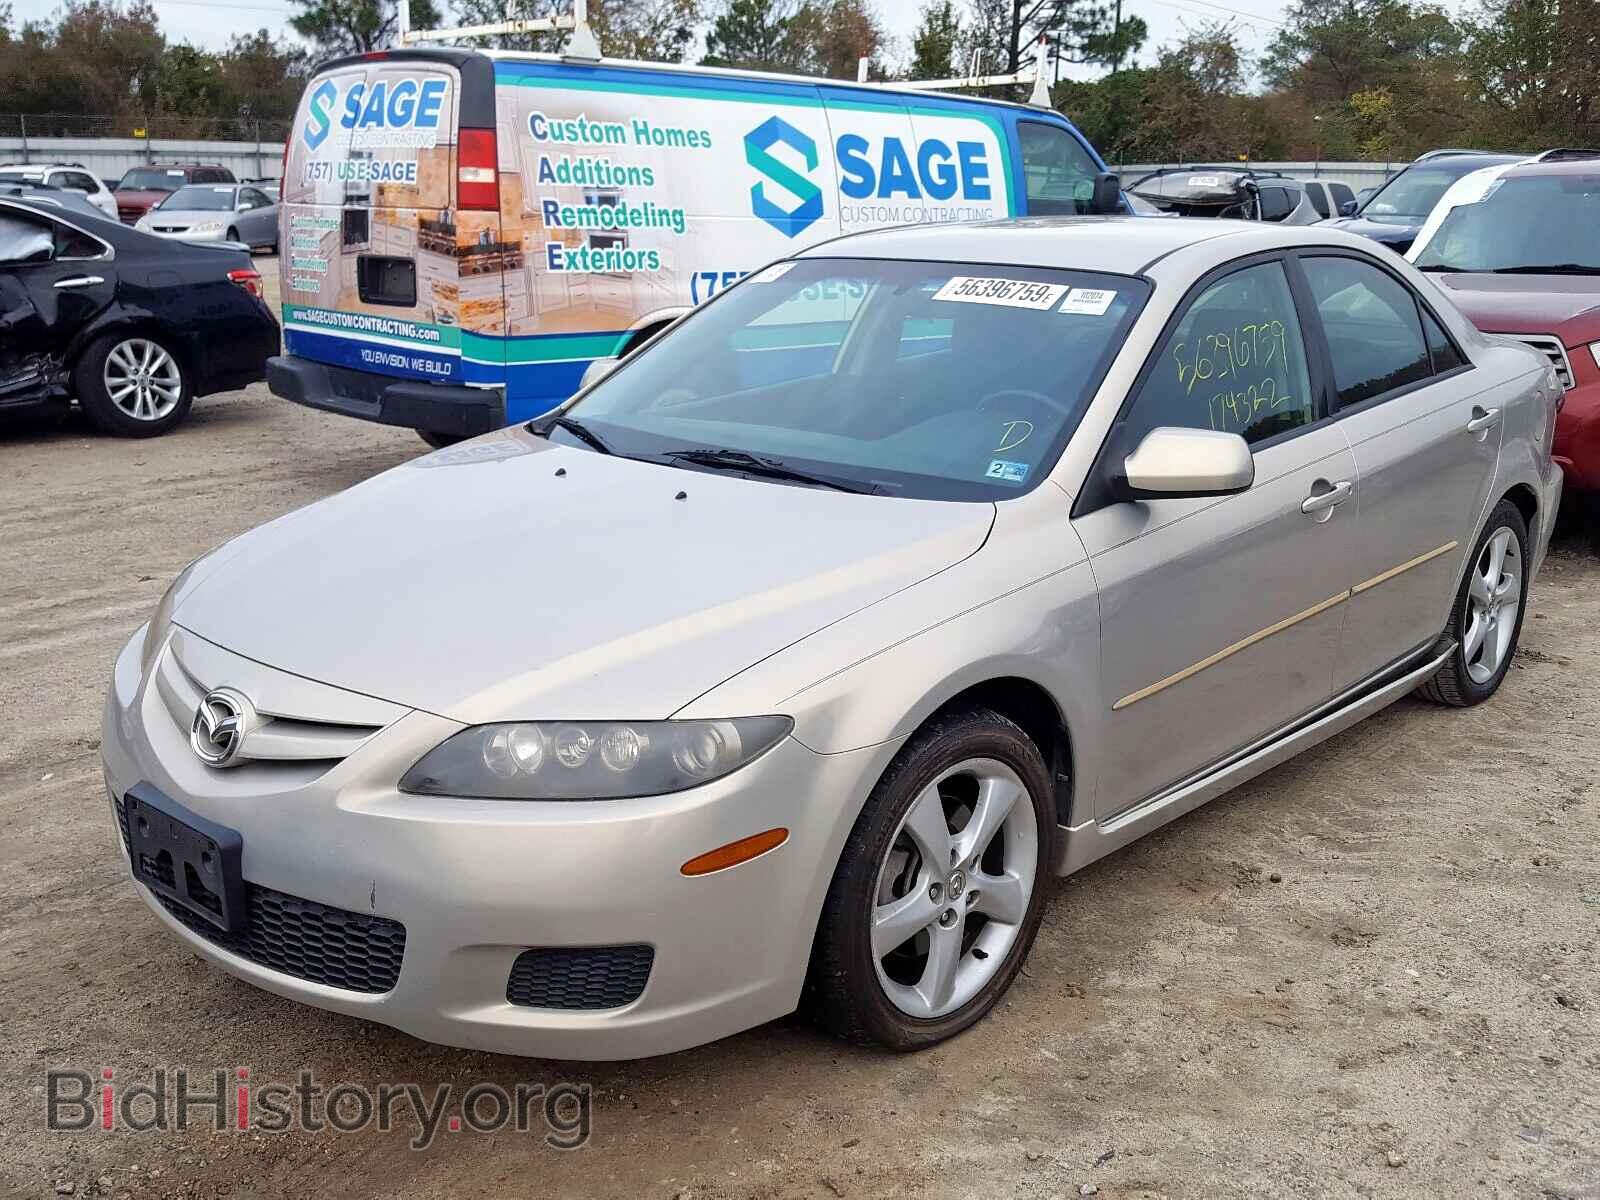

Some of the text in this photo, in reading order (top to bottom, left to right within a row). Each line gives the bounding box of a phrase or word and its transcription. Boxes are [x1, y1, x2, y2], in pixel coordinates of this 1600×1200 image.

[340, 79, 448, 129] SAGE
[530, 113, 712, 148] Custom Homes
[304, 161, 333, 185] (757)
[538, 157, 655, 186] Additions
[836, 133, 992, 200] SAGE
[543, 200, 686, 234] Remodeling
[841, 206, 899, 223] CUSTOM
[547, 244, 660, 271] Exteriors
[954, 279, 1050, 303] 56396759
